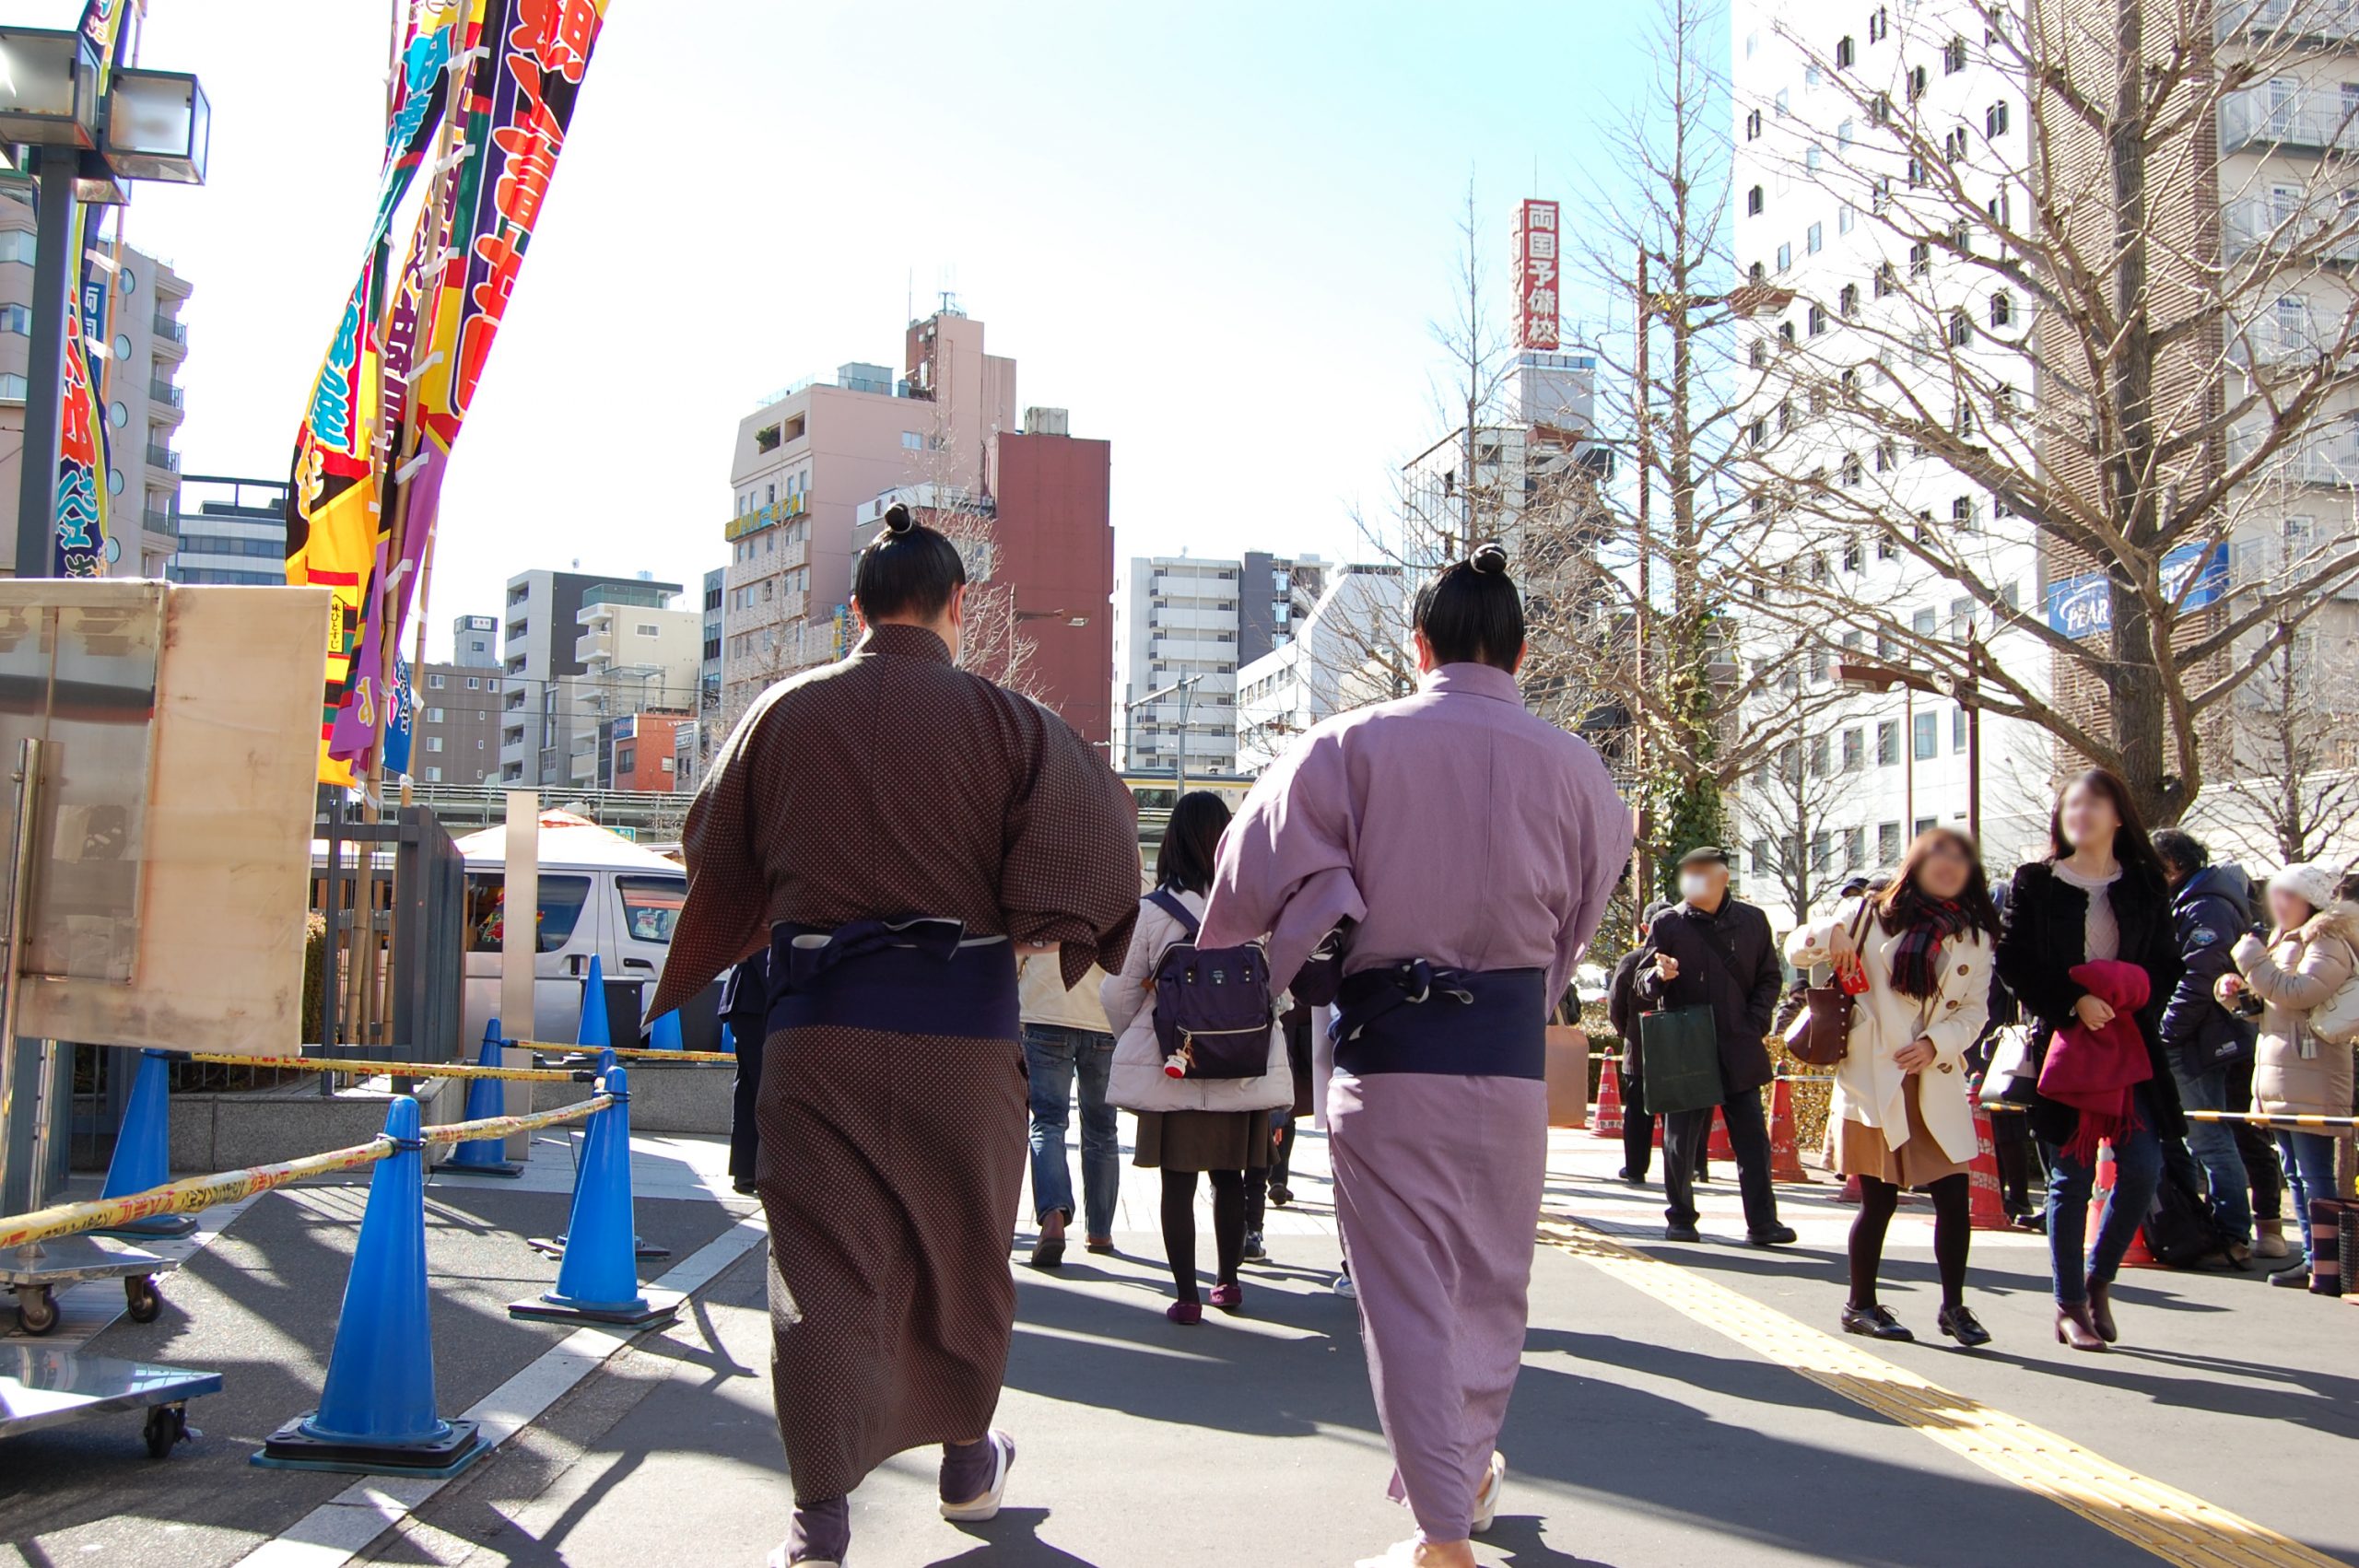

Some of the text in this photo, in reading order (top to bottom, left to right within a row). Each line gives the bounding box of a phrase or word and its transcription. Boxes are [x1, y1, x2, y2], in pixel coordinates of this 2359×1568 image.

[1528, 204, 1556, 344] 両国予備校
[2067, 598, 2109, 631] PEAR
